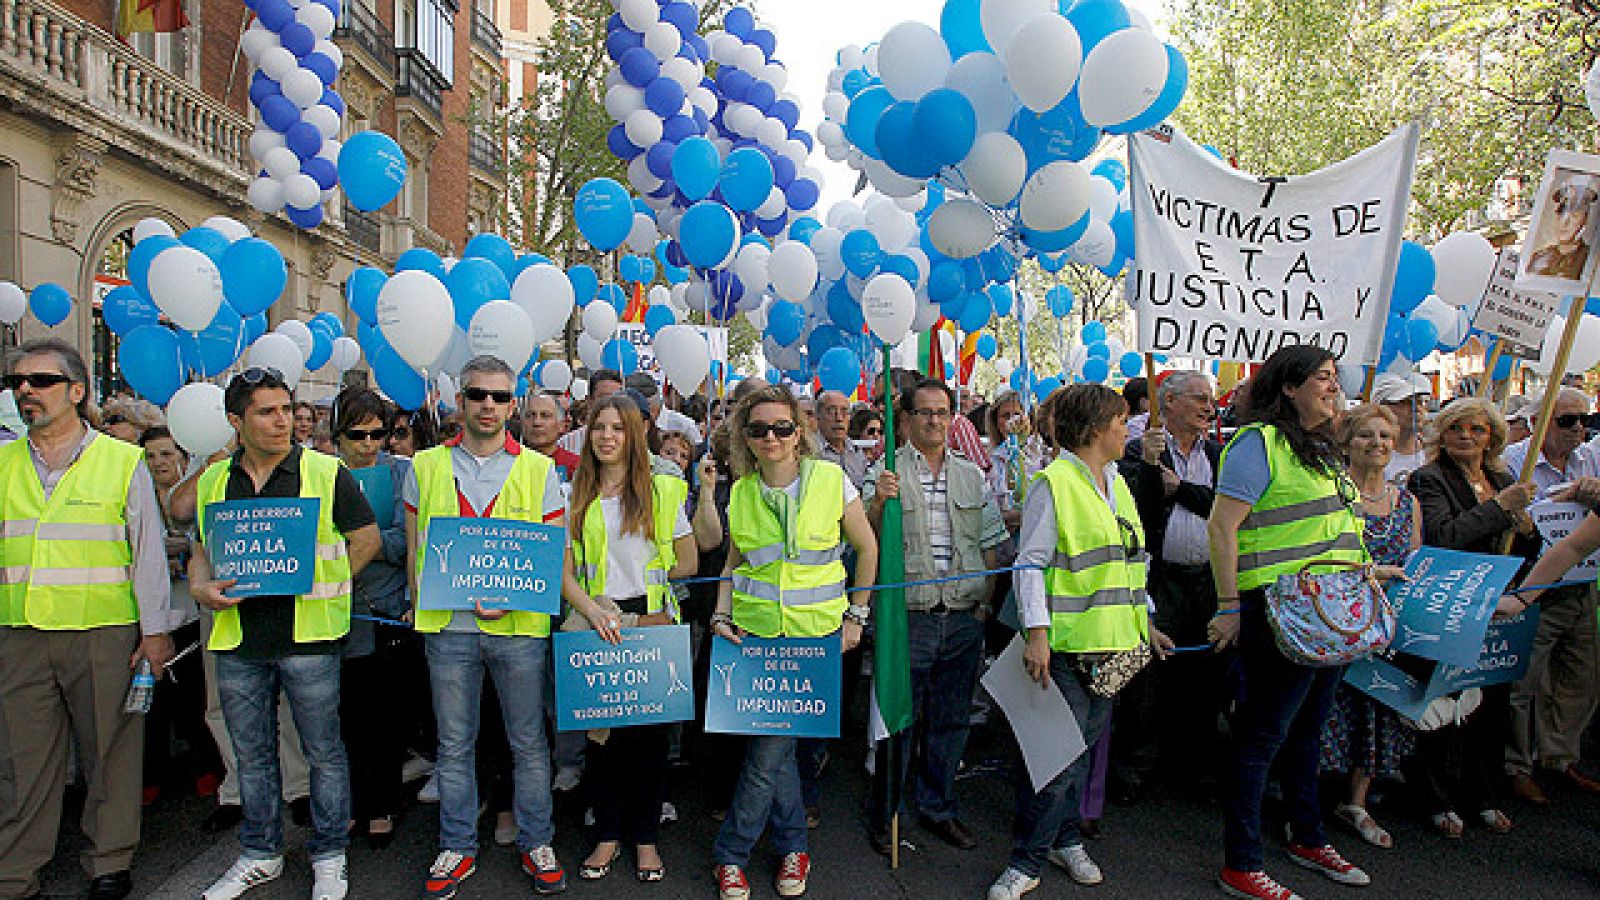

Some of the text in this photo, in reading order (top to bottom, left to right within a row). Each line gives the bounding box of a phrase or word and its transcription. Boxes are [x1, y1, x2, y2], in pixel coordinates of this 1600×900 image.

[1149, 183, 1381, 243] VICTIMAS DE
[1134, 269, 1372, 321] JUSTICIA Y
[237, 509, 250, 520] LA
[235, 522, 249, 533] DE
[459, 525, 483, 536] POR
[484, 526, 499, 538] LA
[224, 537, 286, 556] NO A LA
[483, 539, 498, 550] DE
[469, 554, 534, 572] NO A LA
[452, 575, 546, 593] IMPUNIDAD
[1425, 569, 1466, 613] NO A LA
[1445, 561, 1494, 634] IMPUNIDAD
[764, 647, 776, 657] LA
[1492, 639, 1510, 654] LA
[570, 648, 660, 668] IMPUNIDAD
[765, 660, 778, 671] DE
[585, 669, 649, 688] NO A LA
[752, 677, 813, 693] NO A LA
[736, 697, 826, 716] IMPUNIDAD
